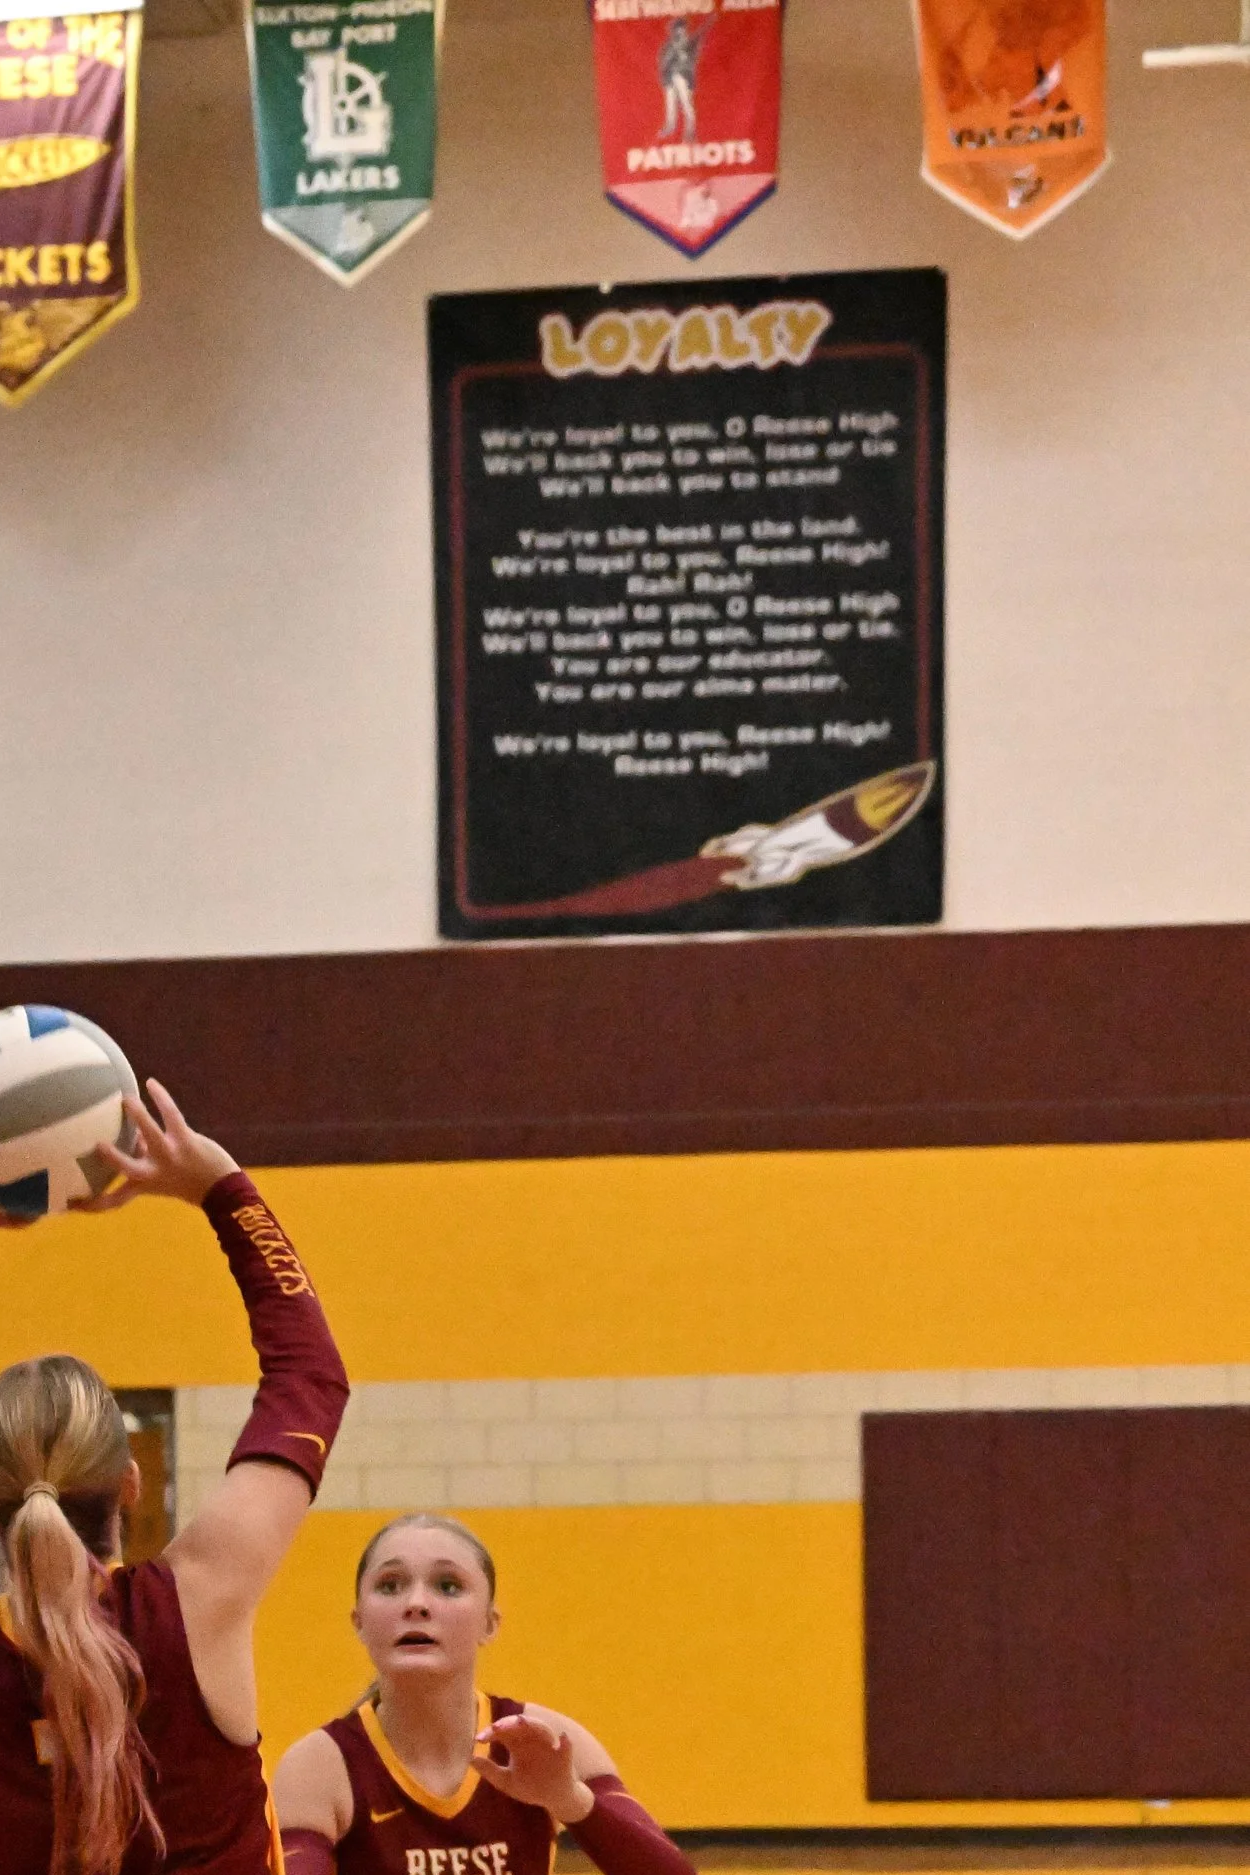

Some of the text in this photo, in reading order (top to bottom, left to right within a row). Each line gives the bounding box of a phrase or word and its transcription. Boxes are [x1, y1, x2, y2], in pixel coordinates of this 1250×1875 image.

[6, 18, 51, 49] OF
[626, 139, 757, 173] PATRIOTS
[296, 164, 401, 196] LAKERS
[539, 301, 834, 379] LOYALTY
